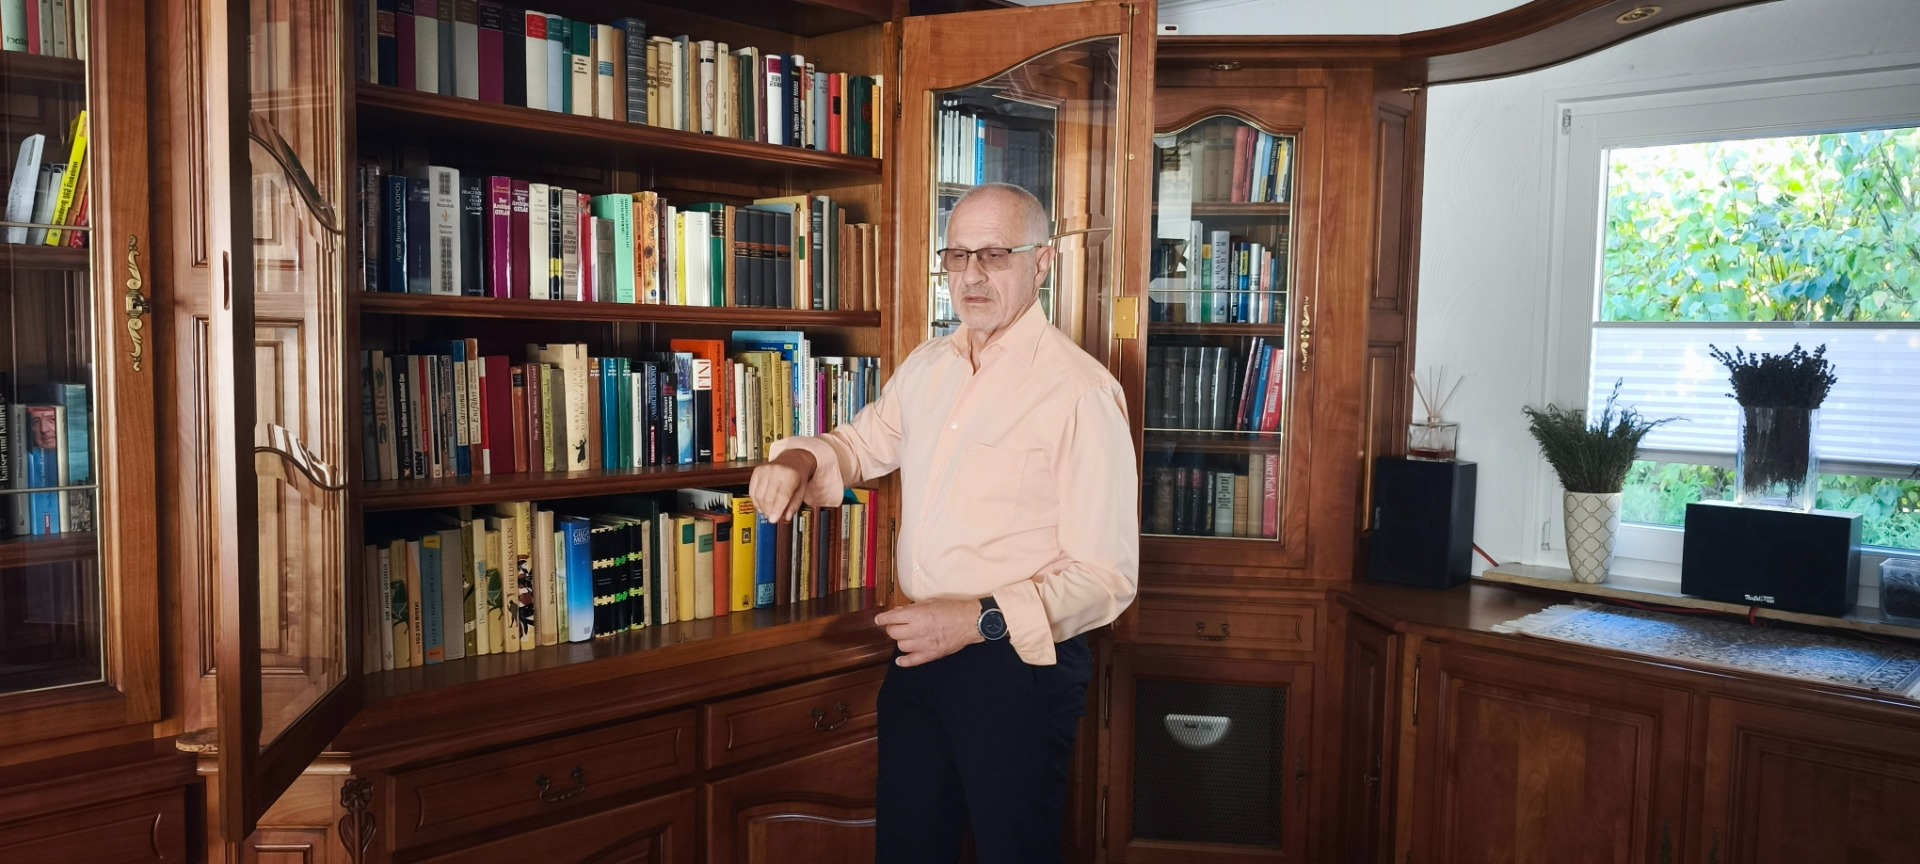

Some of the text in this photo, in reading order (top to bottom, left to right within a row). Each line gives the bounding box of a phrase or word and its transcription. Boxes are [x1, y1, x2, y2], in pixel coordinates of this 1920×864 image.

[367, 167, 377, 227] Durango Street
[459, 393, 467, 426] Catriona
[1266, 455, 1278, 476] Kaiser
[1266, 476, 1277, 491] Karl
[507, 527, 516, 589] HELDENSAGEN
